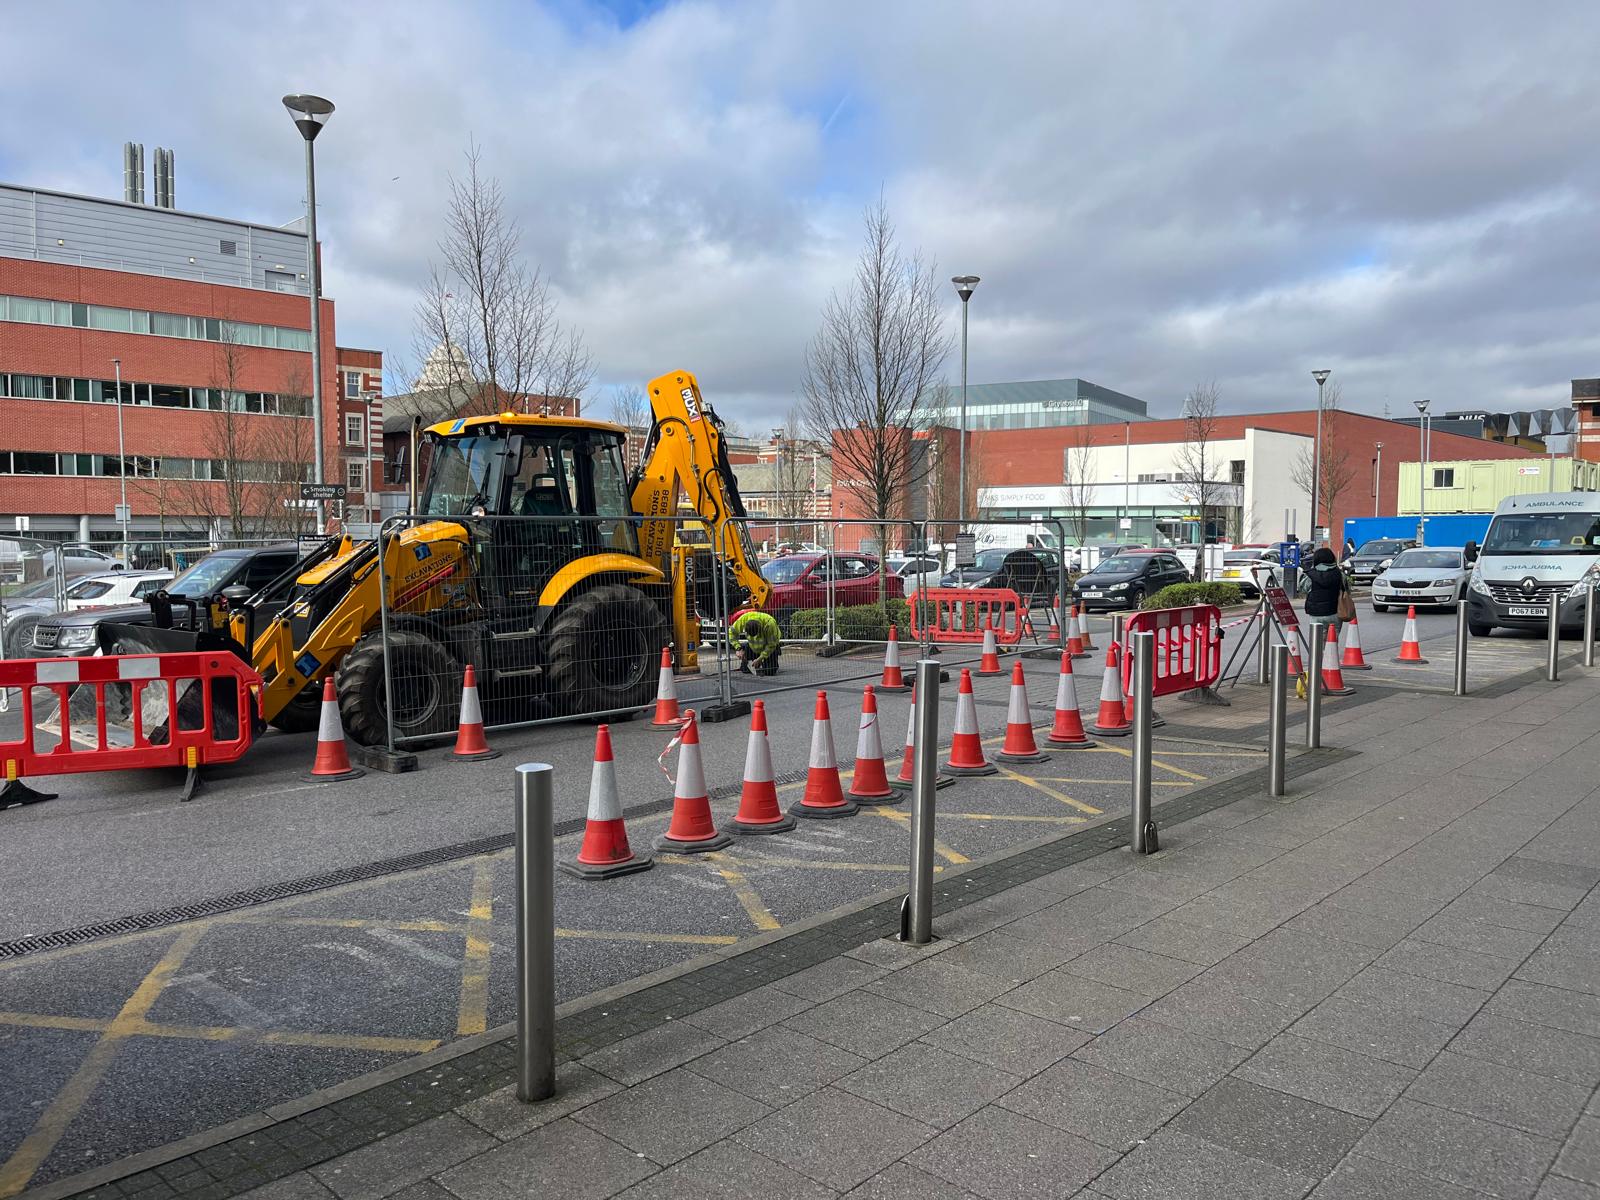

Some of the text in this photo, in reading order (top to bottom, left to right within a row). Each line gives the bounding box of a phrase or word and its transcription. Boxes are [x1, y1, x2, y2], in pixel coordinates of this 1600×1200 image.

[681, 388, 699, 417] 3CX
[645, 489, 660, 558] EXCAVAIONS
[685, 557, 694, 583] 3CX
